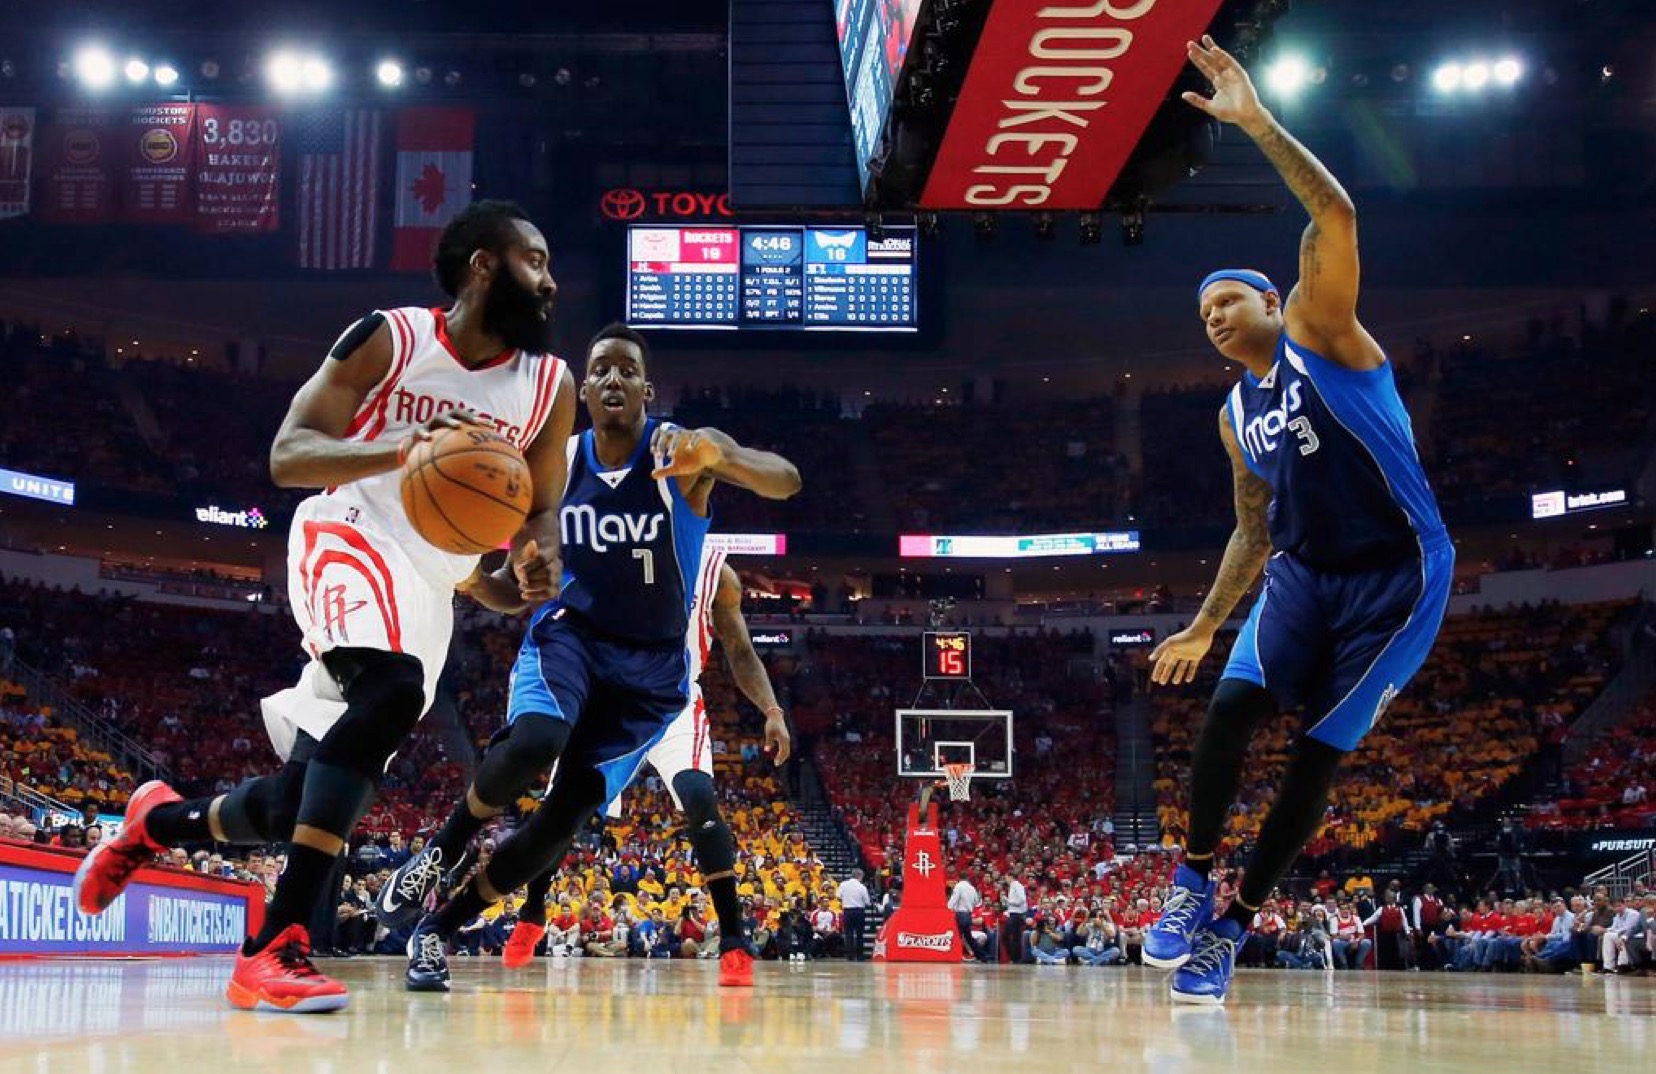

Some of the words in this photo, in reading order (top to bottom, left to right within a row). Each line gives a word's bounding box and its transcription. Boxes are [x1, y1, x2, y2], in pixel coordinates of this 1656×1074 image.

[204, 118, 276, 149] 3,830
[1288, 415, 1320, 456] 3
[560, 504, 664, 553] Mavs
[936, 637, 965, 651] 4:46
[940, 651, 961, 674] 15
[154, 896, 246, 945] NBATICKETS.COM
